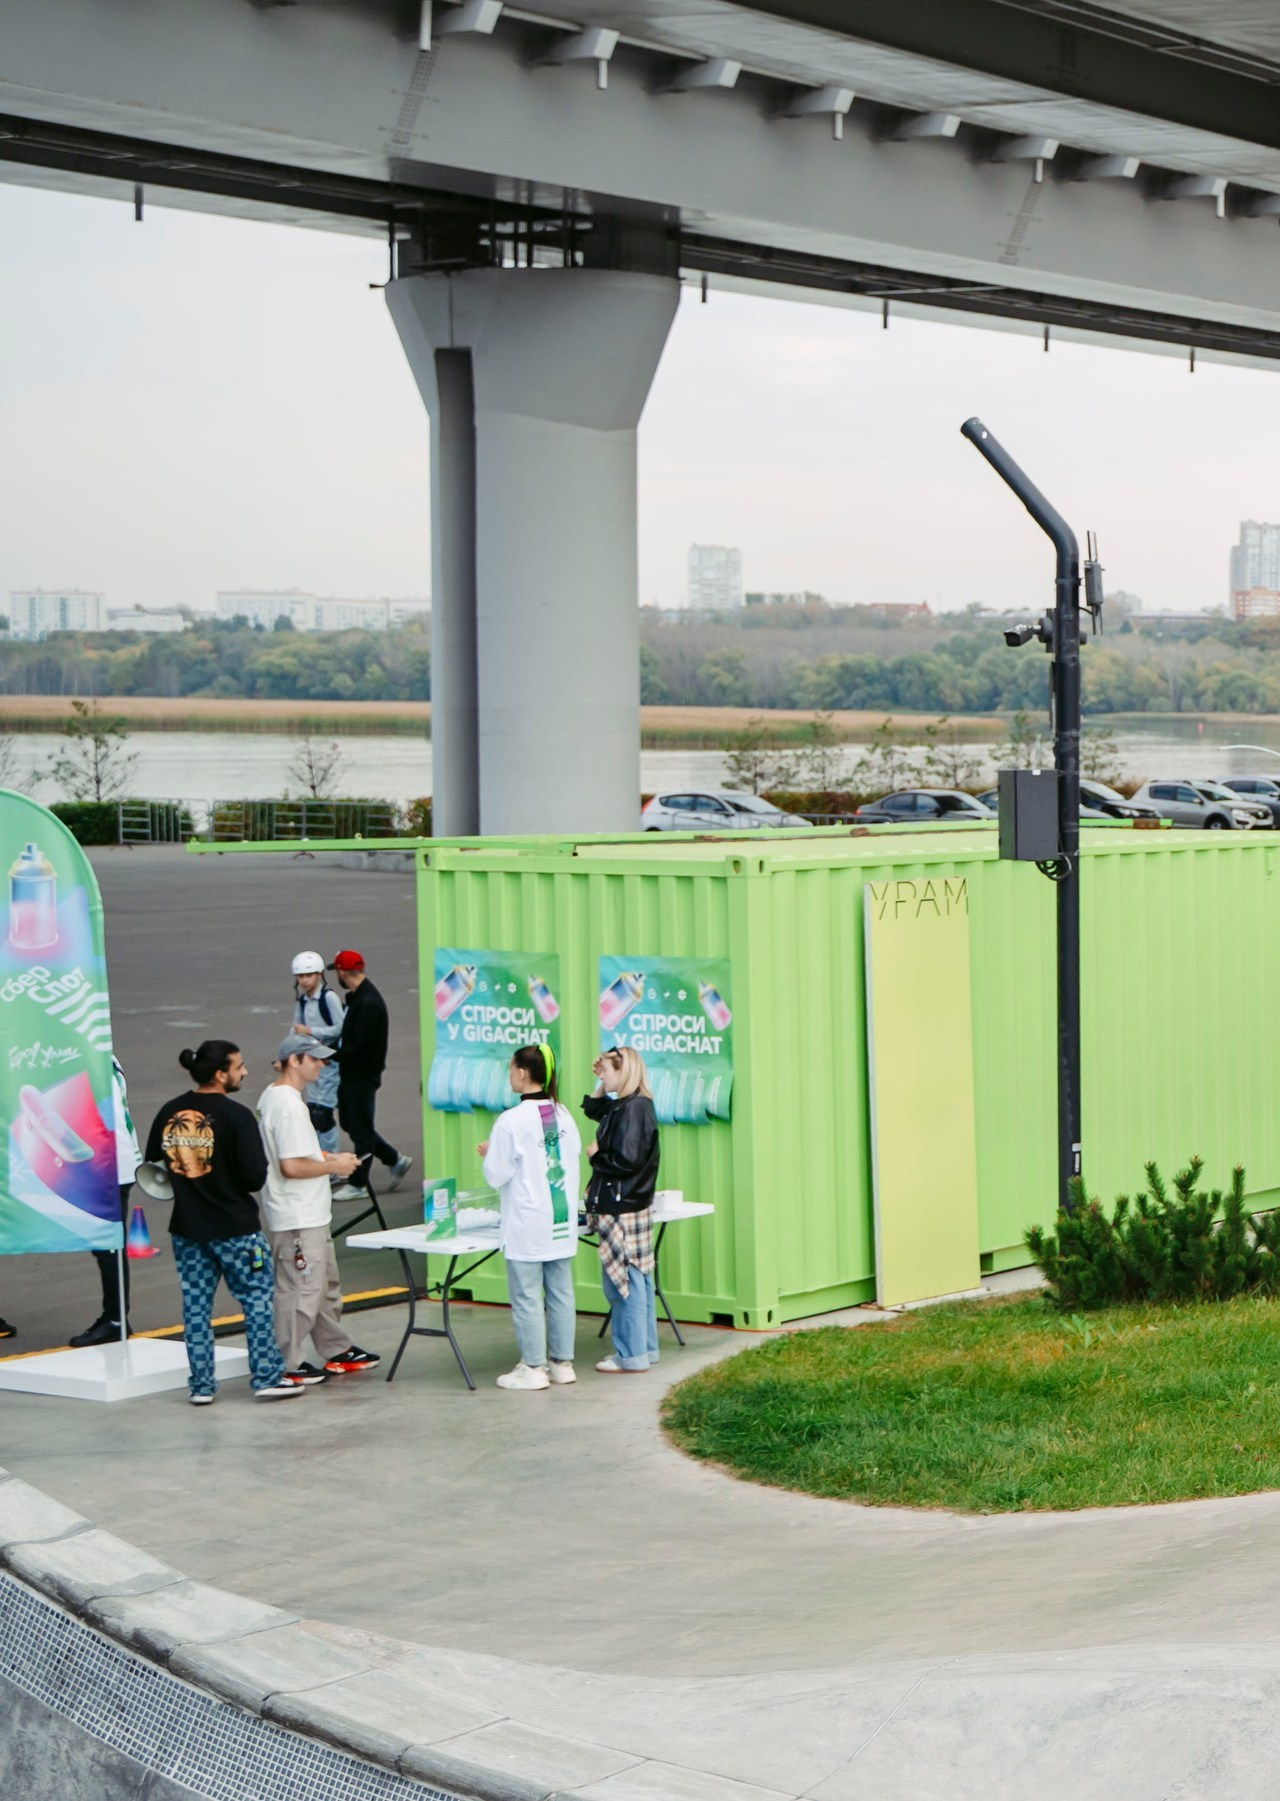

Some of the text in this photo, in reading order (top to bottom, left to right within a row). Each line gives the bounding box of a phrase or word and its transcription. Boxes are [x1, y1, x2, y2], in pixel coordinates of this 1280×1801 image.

[869, 878, 969, 920] УРАМ
[461, 1004, 536, 1026] СПРОСИ
[628, 1013, 706, 1034] СПРОСИ
[447, 1023, 550, 1045] У GIGACHAT
[630, 1033, 723, 1055] GIGACHAT
